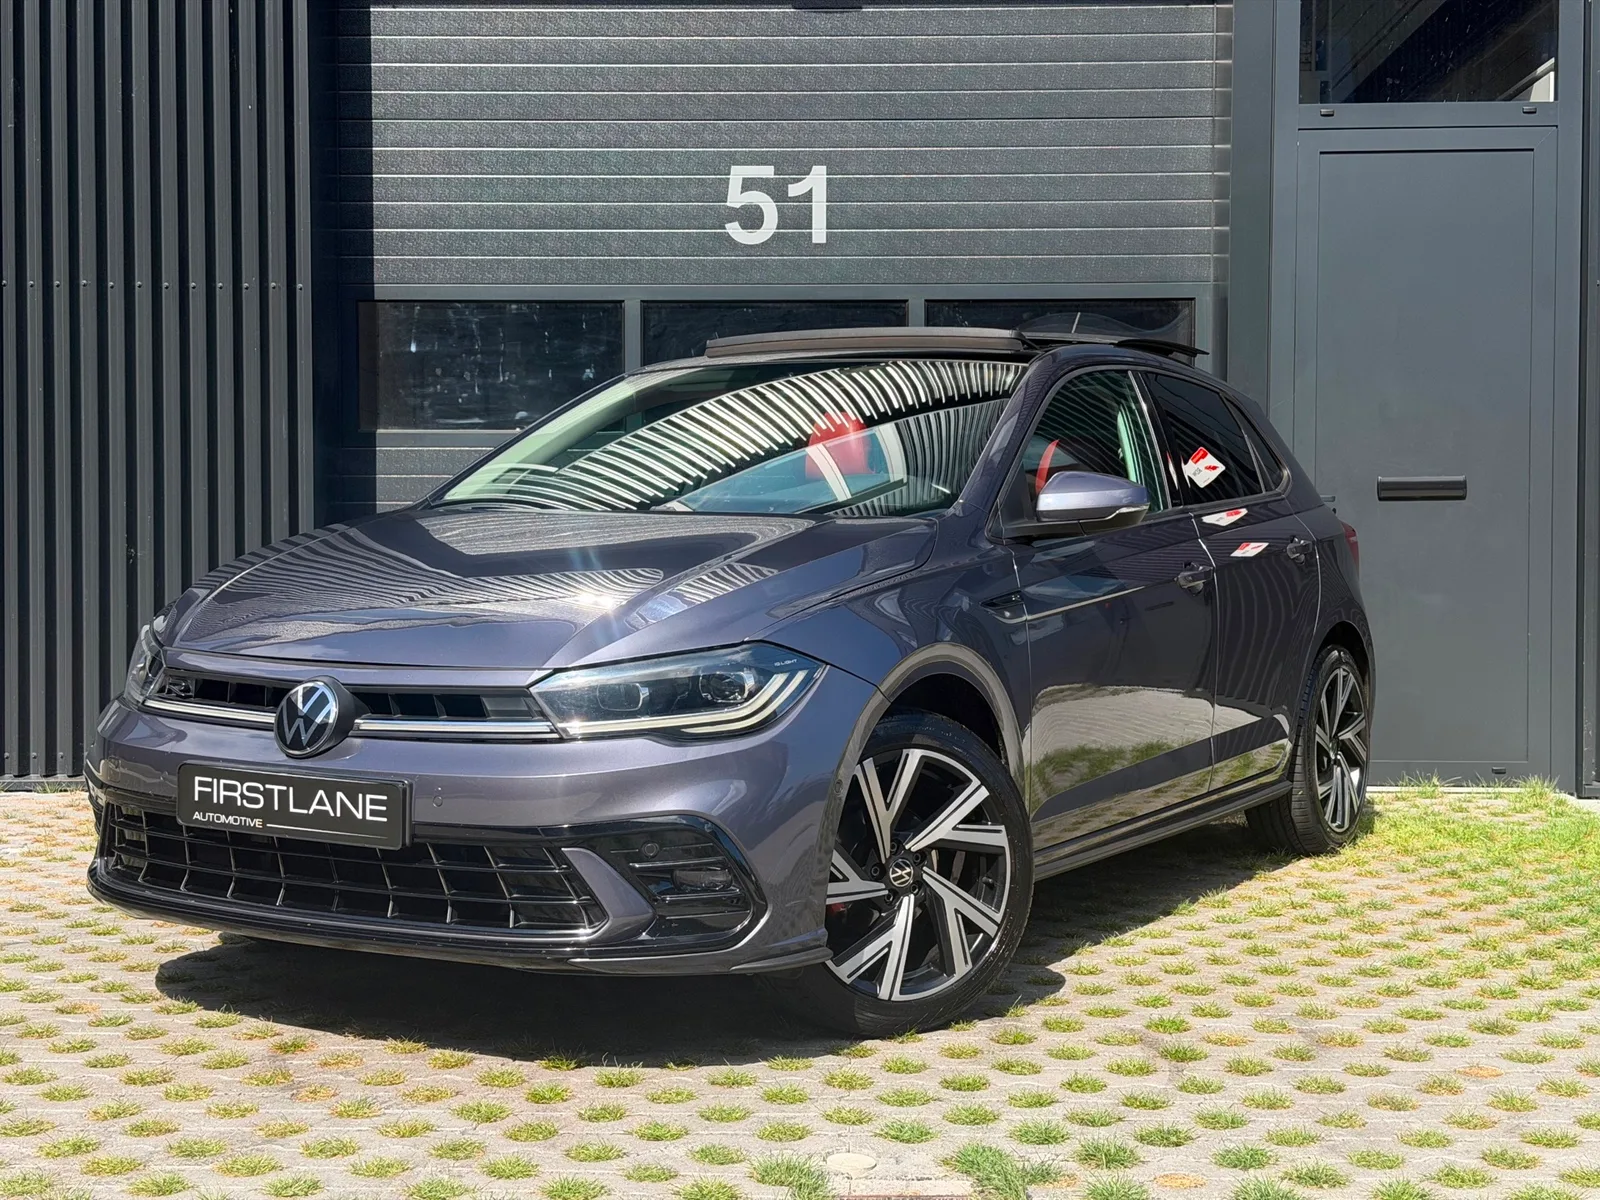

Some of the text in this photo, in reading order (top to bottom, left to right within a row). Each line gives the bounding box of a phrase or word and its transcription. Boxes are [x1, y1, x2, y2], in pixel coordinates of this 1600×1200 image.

[725, 165, 827, 245] 51
[192, 811, 263, 828] AUTOMOTIVE
[193, 776, 389, 822] FIRSTLANE
